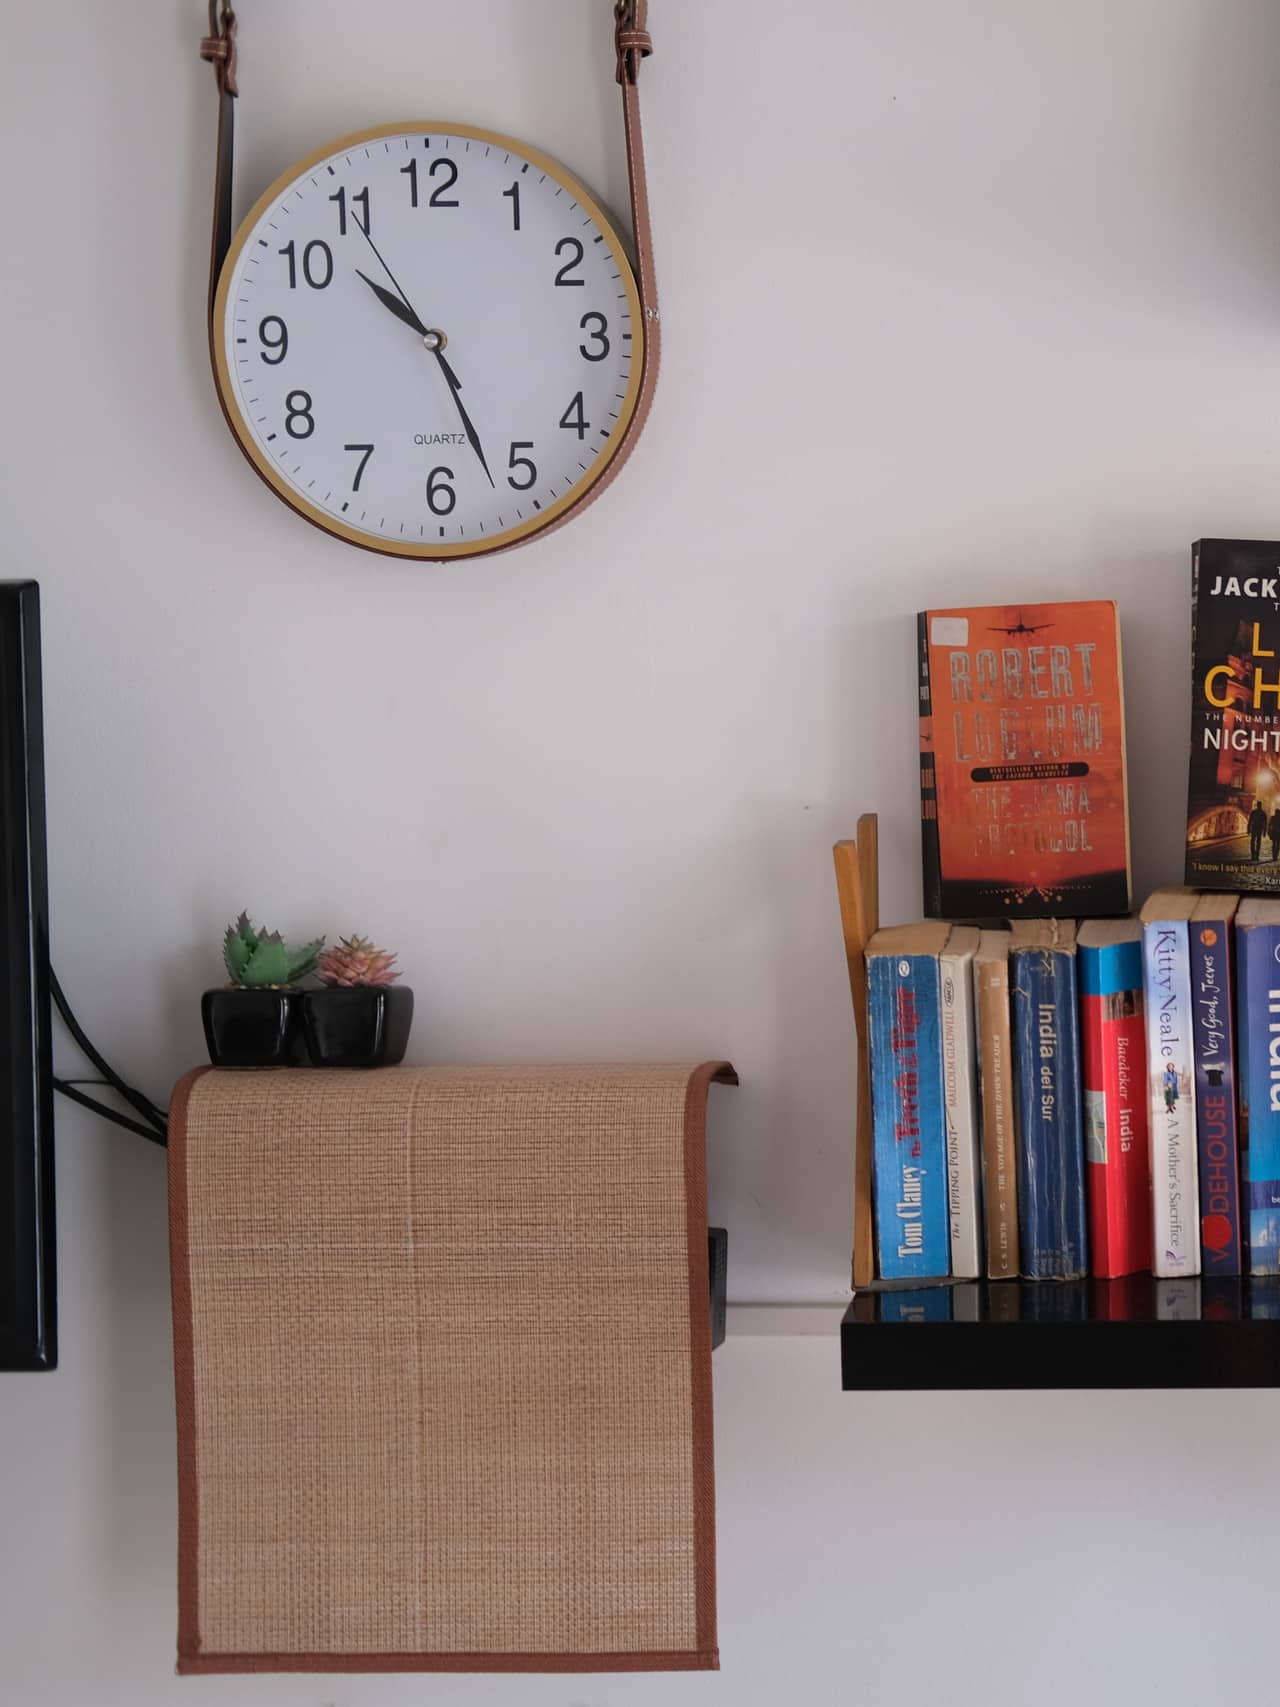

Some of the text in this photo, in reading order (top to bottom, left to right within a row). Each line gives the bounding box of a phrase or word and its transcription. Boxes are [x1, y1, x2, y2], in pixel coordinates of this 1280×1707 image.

[399, 158, 460, 208] 12
[502, 181, 521, 231] 1
[328, 186, 371, 236] 11
[278, 239, 334, 290] 10
[553, 238, 585, 287] 2
[258, 315, 289, 366] 9
[579, 311, 610, 362] 3
[284, 390, 315, 440] 8
[413, 432, 466, 446] QUARTZ
[558, 391, 590, 440] 4
[343, 444, 375, 492] 7
[425, 466, 457, 516] 6
[507, 441, 538, 491] 5
[1210, 575, 1277, 599] JACK
[950, 643, 1097, 705] ROBERT
[1205, 713, 1228, 722] THE
[1155, 929, 1178, 1057] Kitty Neale
[1199, 954, 1225, 1057] Very Good, Jeeves
[944, 1010, 956, 1060] GLADWELL
[946, 1062, 957, 1108] MALCOLM
[1038, 1003, 1056, 1121] India del Sur
[1116, 1037, 1134, 1153] Baedeker India
[949, 1129, 960, 1166] POINT
[896, 1164, 928, 1218] Clancy
[950, 1170, 961, 1217] TIPPING
[1166, 1118, 1182, 1247] A Mother's Sacrifice
[1204, 1096, 1230, 1263] WDEHOUSE
[897, 1222, 923, 1258] Tom
